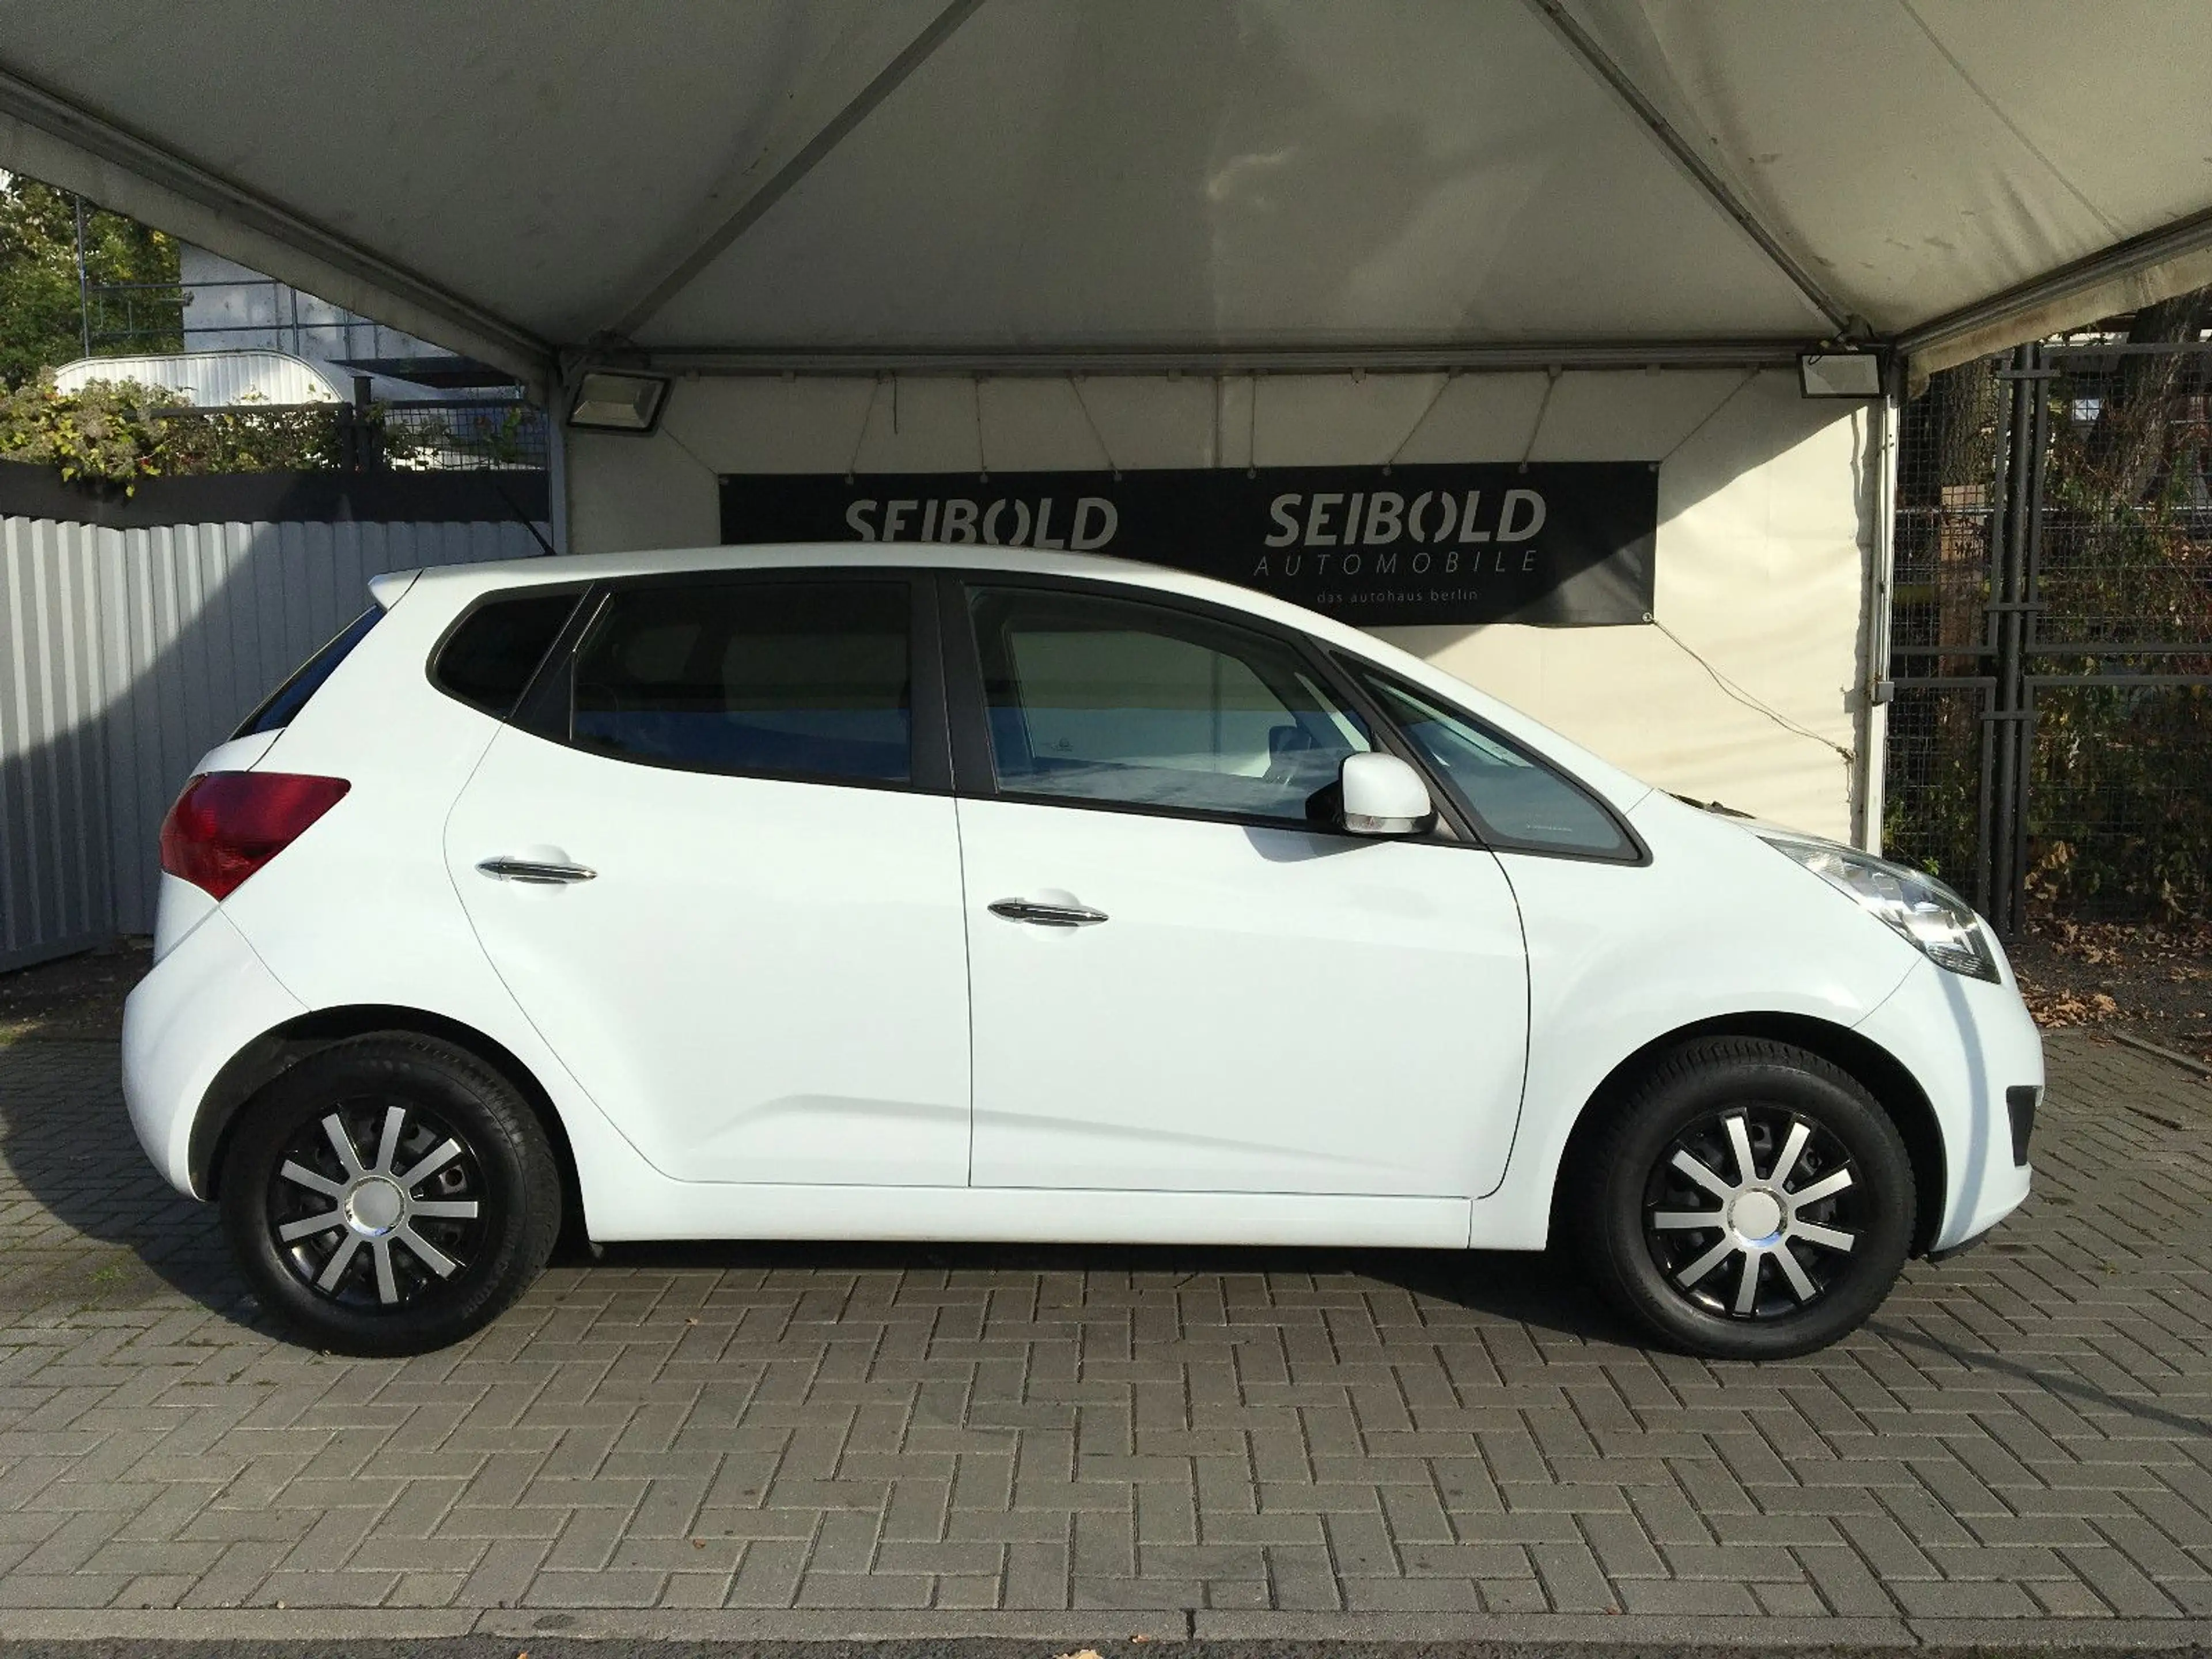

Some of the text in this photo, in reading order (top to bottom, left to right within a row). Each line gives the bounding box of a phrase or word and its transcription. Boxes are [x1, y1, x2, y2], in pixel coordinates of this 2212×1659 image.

[846, 497, 1118, 550] SEIBOLD
[1264, 489, 1547, 547] SEIBOLD
[1253, 550, 1537, 576] AUTOMOBILE
[1317, 589, 1479, 604] das autohaus berlin
